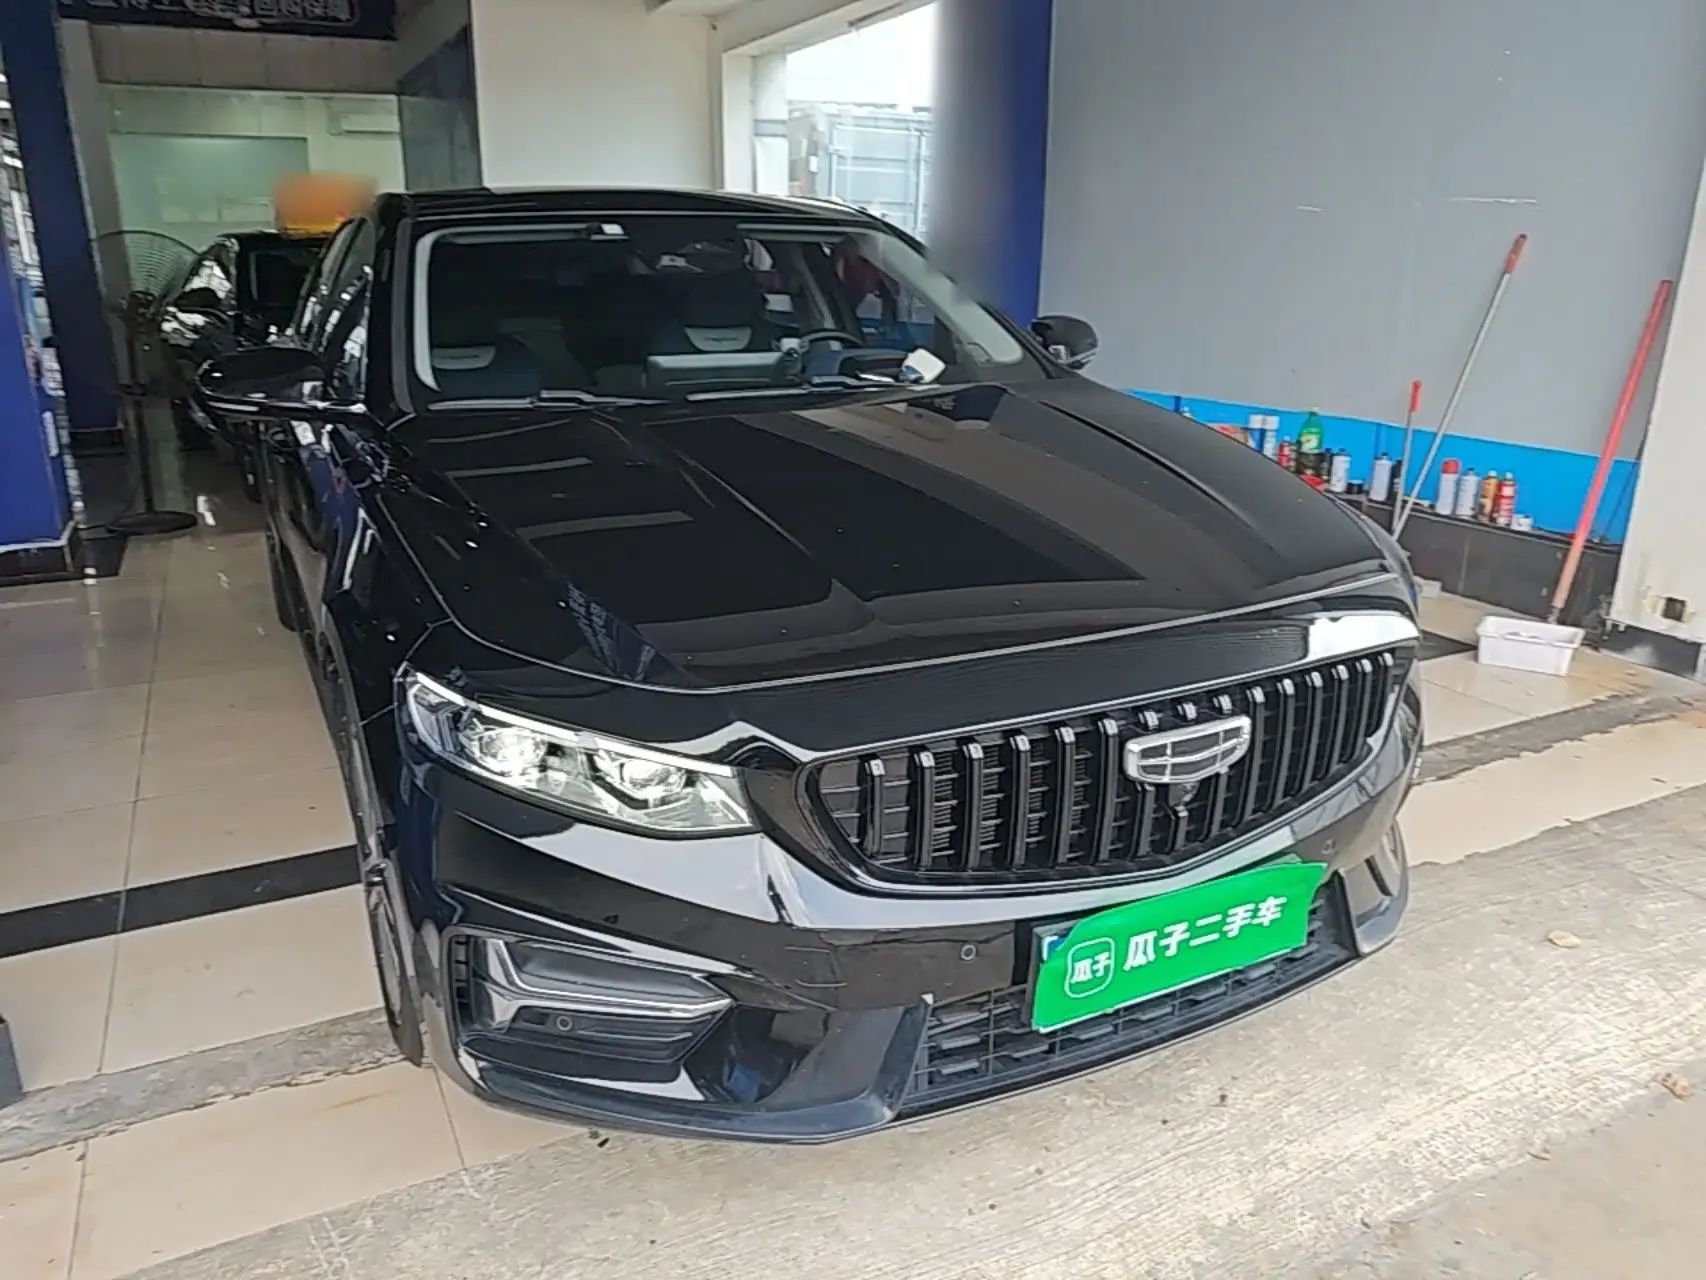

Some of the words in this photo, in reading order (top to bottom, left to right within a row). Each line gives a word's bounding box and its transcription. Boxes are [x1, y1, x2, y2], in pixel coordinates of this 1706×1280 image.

[1124, 896, 1288, 971] 瓜子二手车
[1071, 952, 1112, 983] 瓜子
